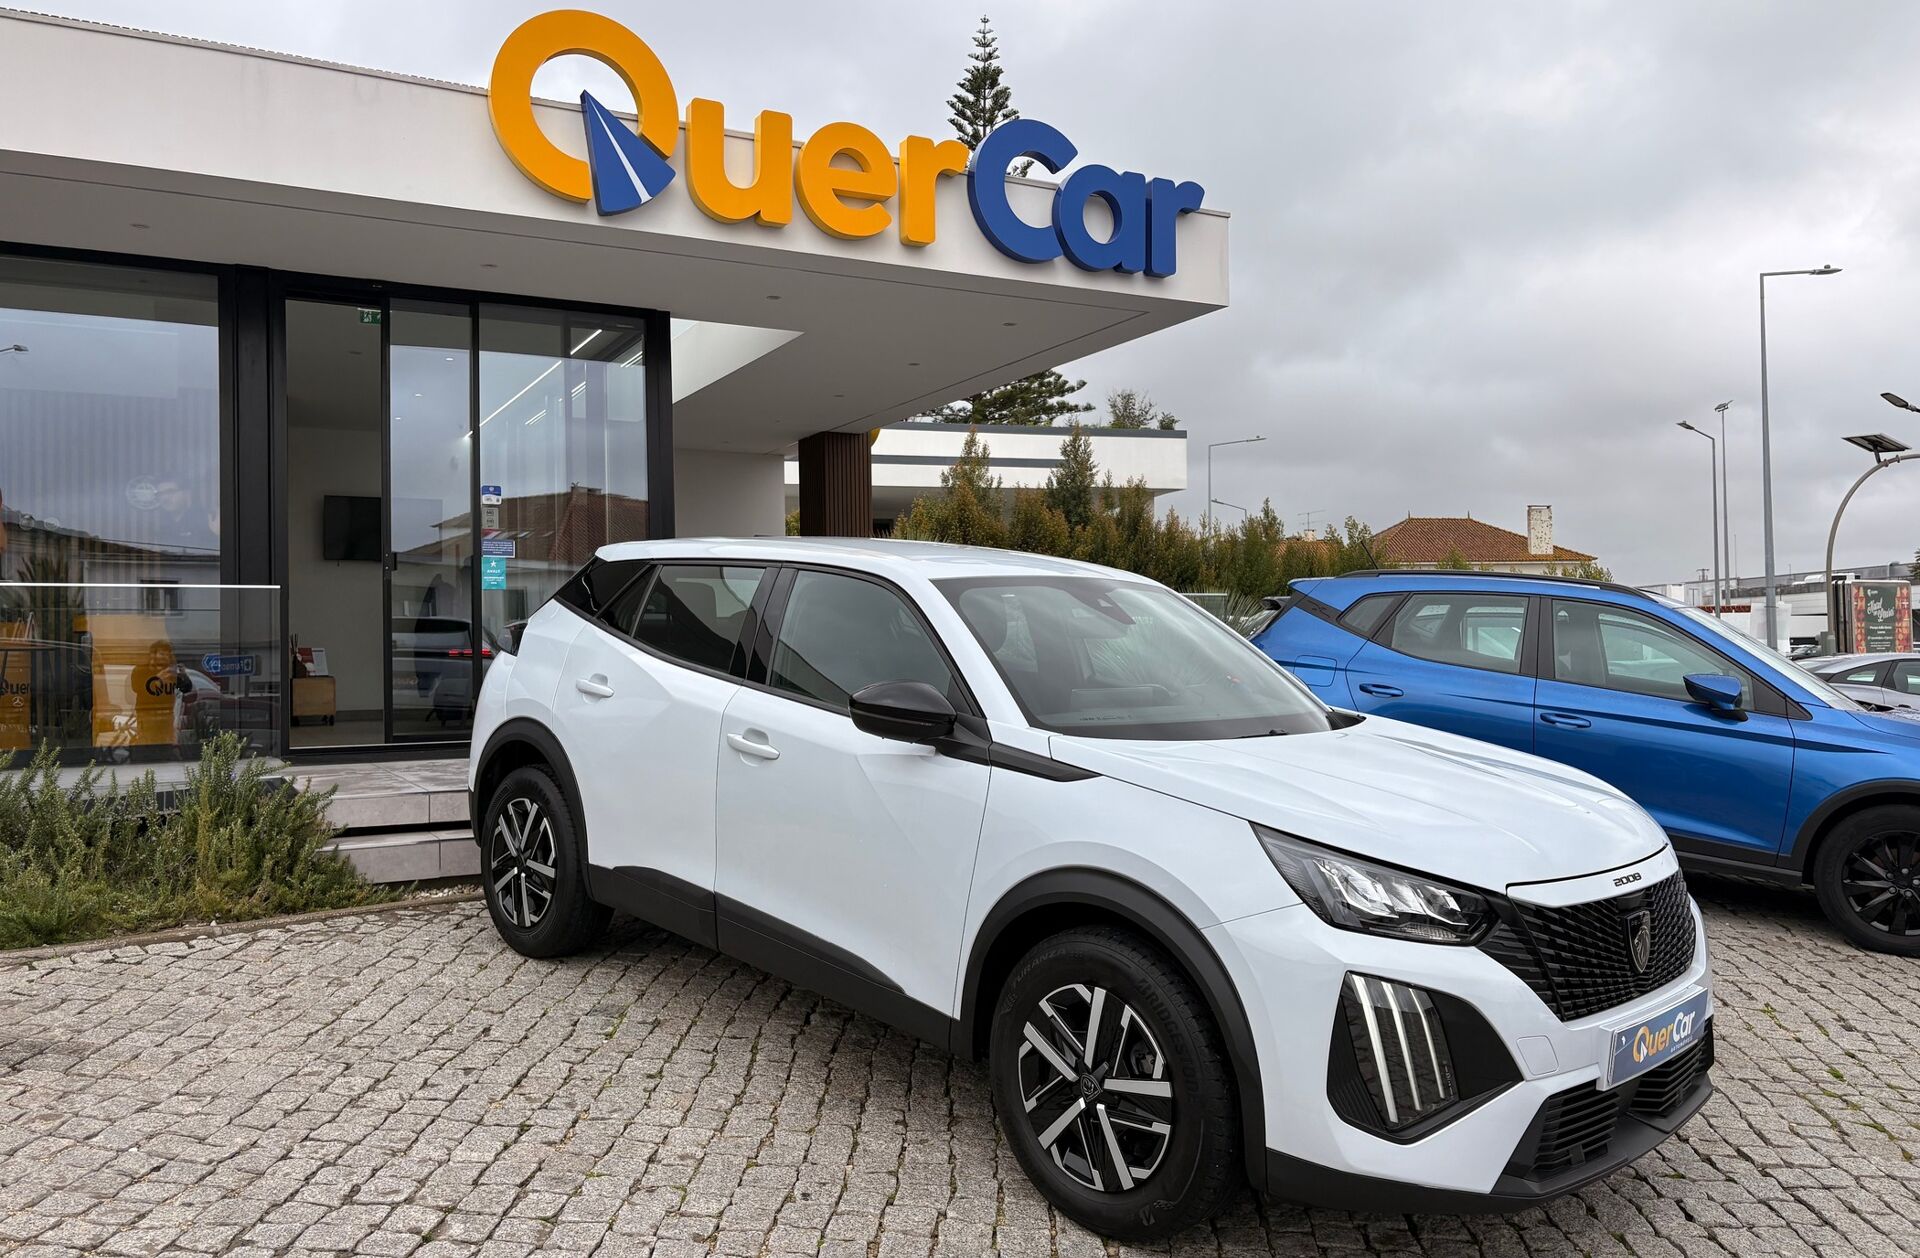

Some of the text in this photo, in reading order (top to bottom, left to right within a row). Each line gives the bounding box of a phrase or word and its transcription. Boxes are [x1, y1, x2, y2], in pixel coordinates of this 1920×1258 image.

[489, 9, 1204, 278] QuerCar
[1613, 872, 1642, 887] 2008
[1633, 1011, 1695, 1063] QuerCar
